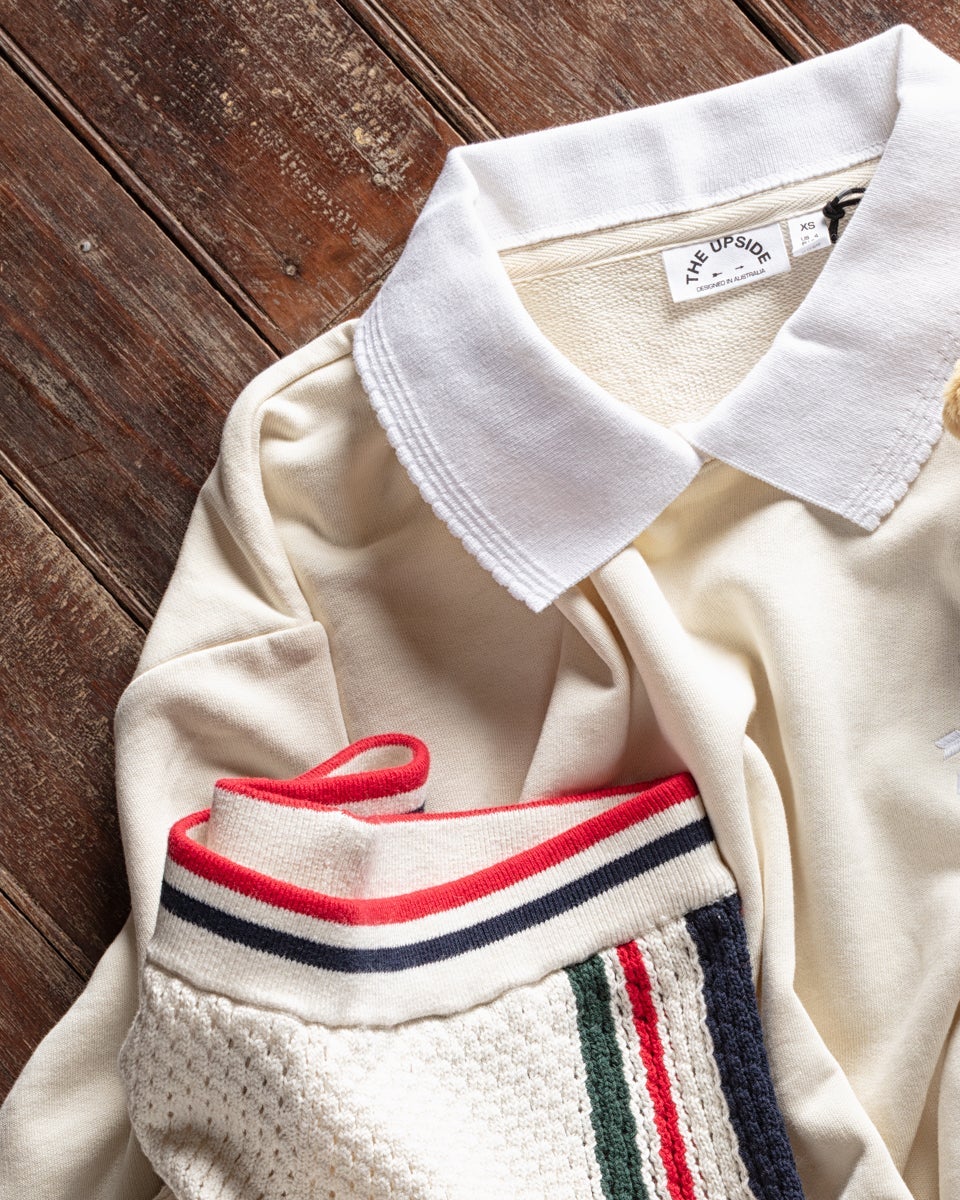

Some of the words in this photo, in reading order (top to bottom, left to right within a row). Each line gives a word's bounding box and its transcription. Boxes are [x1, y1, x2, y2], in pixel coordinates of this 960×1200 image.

[800, 222, 815, 231] XS
[686, 250, 709, 284] THE
[709, 236, 772, 265] UPSIDE
[696, 280, 726, 292] DESIGNED
[734, 268, 766, 282] AUSTRALIA
